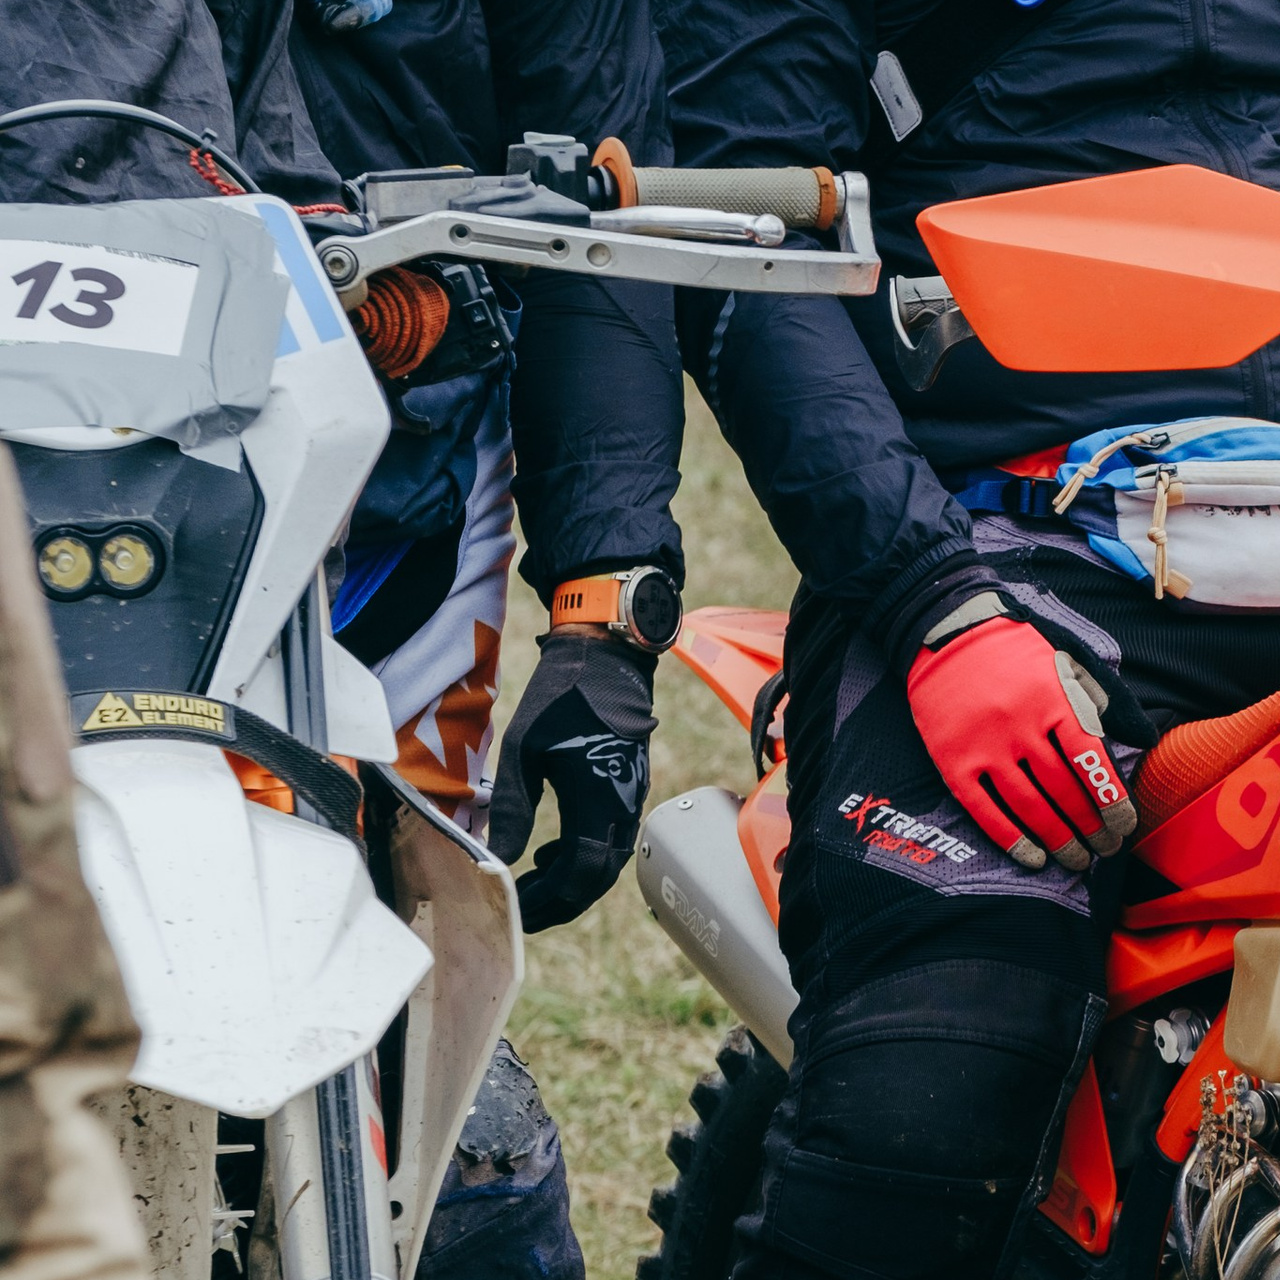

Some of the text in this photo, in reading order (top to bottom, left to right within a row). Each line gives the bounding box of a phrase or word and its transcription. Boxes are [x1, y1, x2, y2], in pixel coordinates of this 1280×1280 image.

[11, 260, 126, 330] 13
[132, 694, 224, 721] ENDURO
[141, 711, 225, 732] ELEMENT
[1073, 750, 1119, 804] POC
[838, 793, 978, 863] EXTREME
[661, 875, 720, 958] 6DAYS
